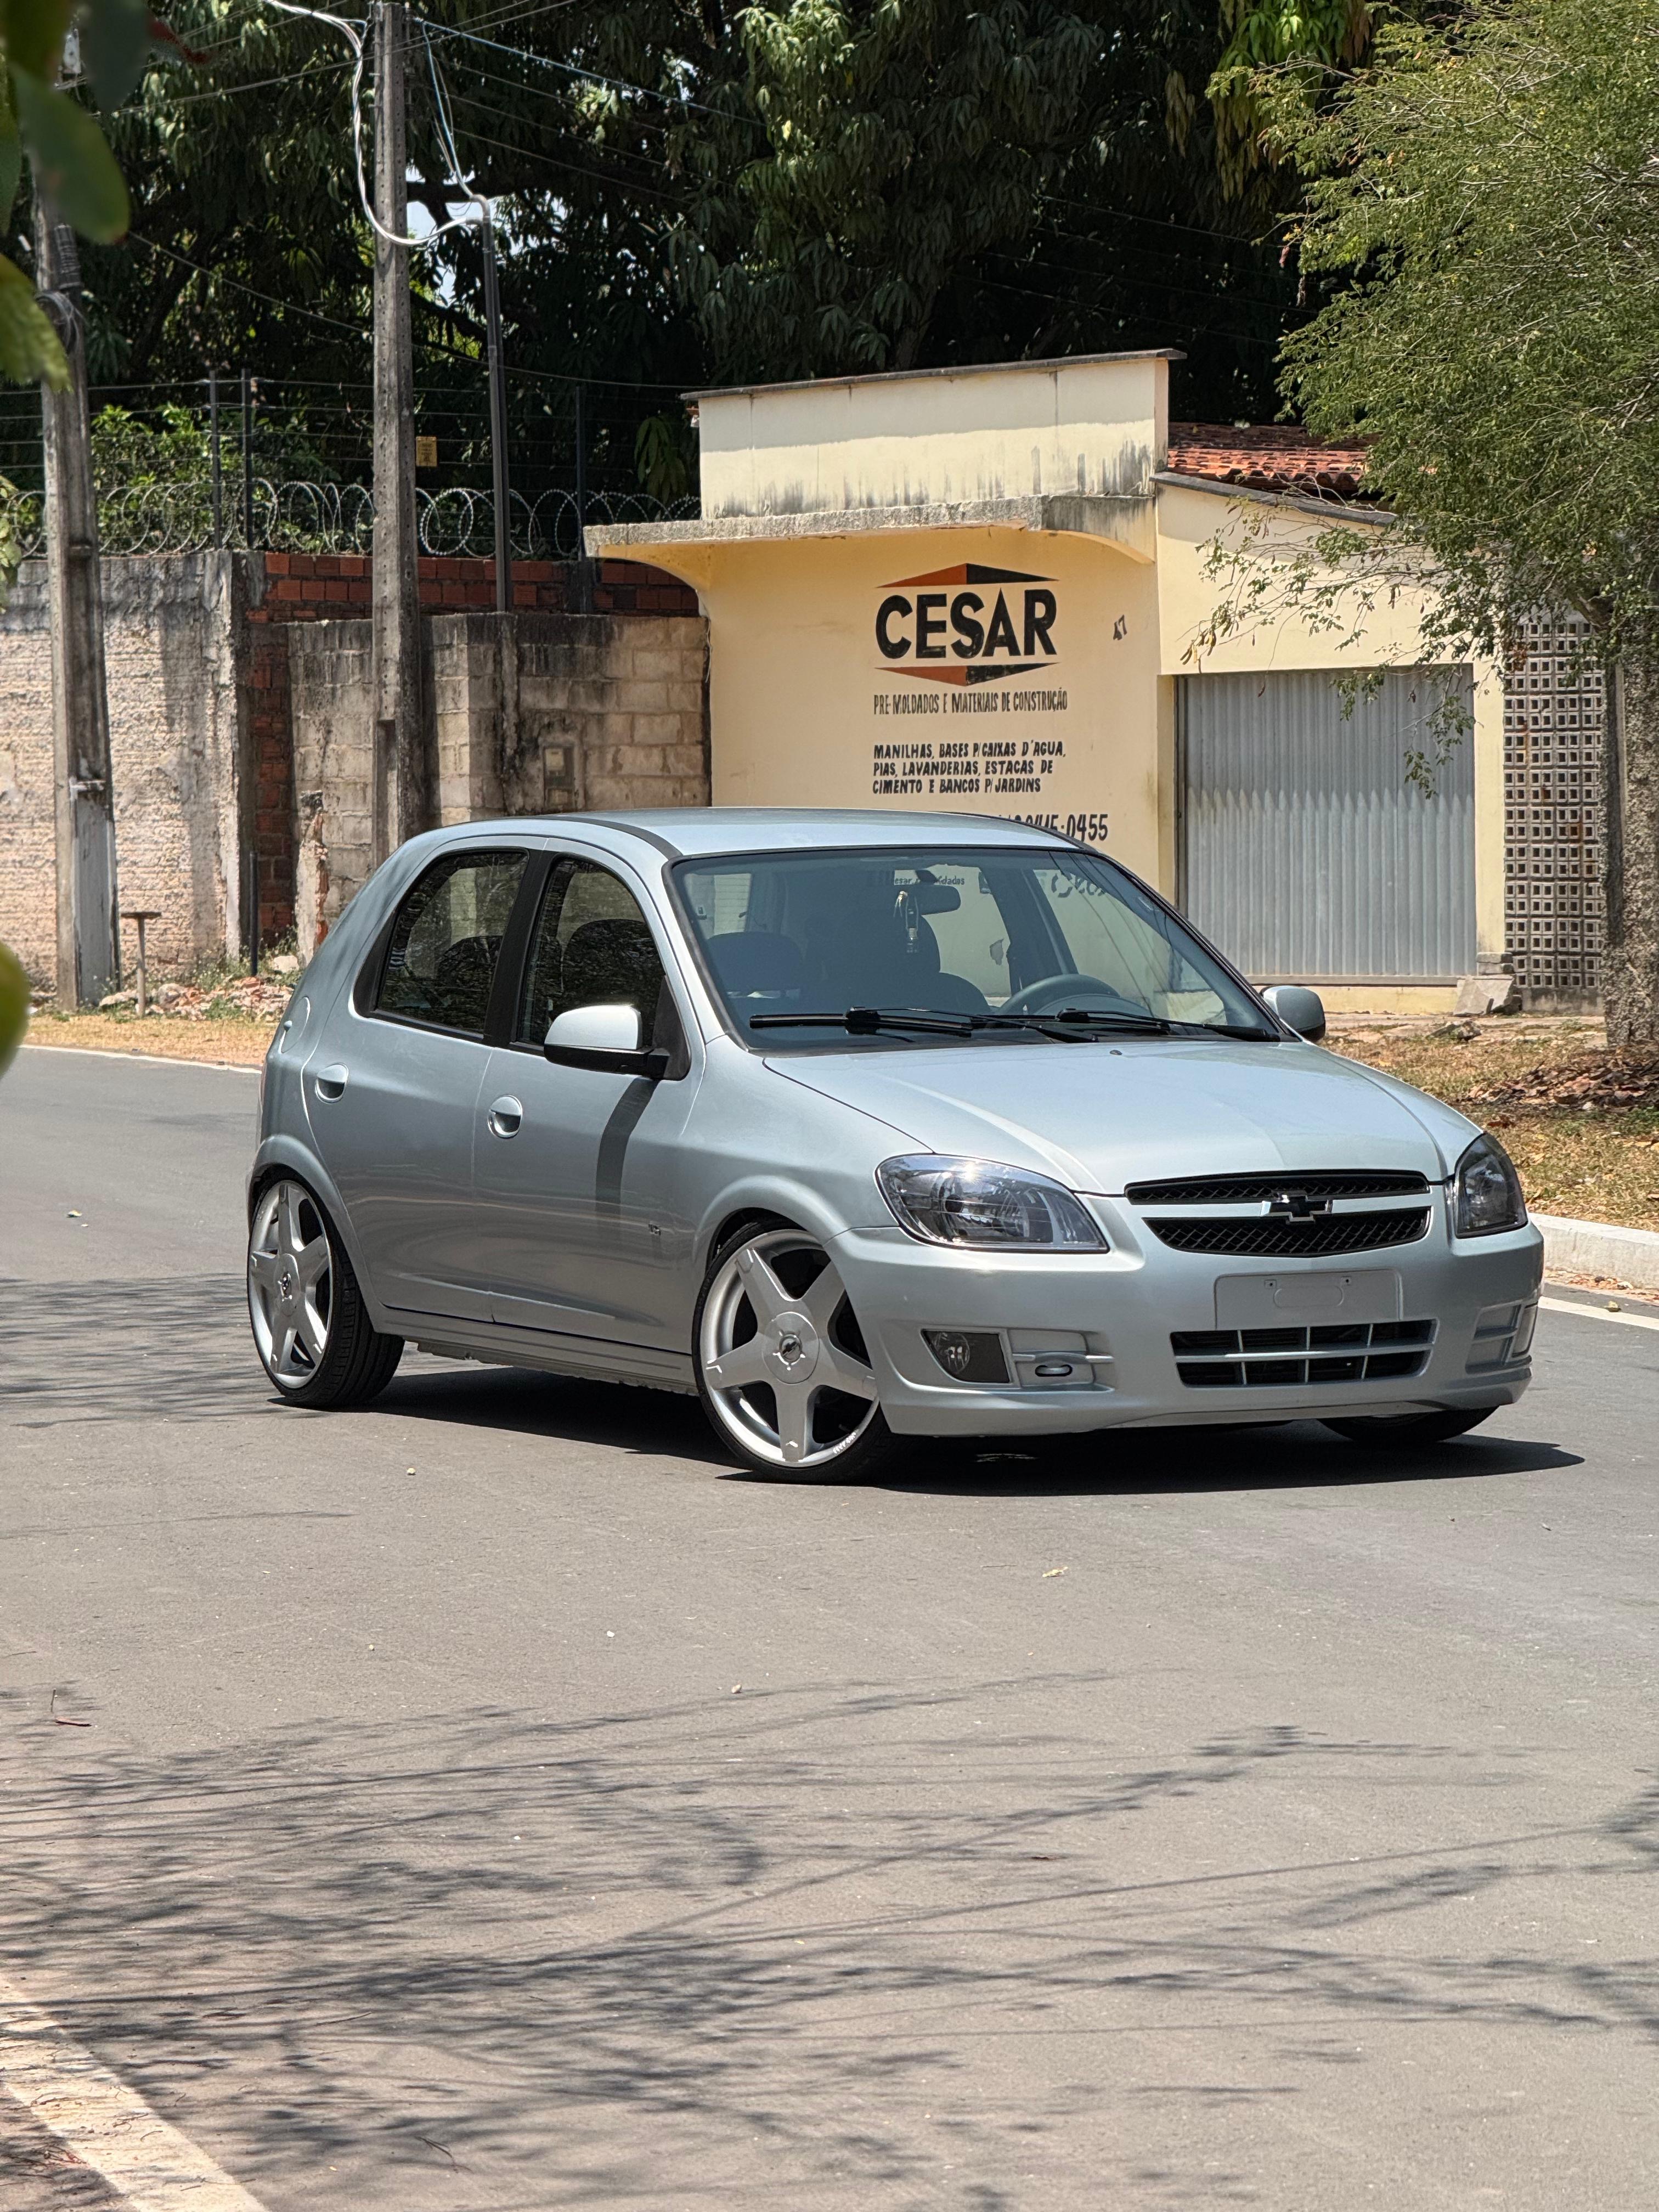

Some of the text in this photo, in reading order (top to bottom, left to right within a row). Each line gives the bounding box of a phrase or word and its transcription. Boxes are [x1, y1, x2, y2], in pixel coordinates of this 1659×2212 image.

[876, 588, 1057, 659] CESAR
[943, 693, 948, 714] E
[952, 692, 998, 713] MATERIAIS
[1002, 691, 1011, 712] DE
[874, 744, 934, 759] MANILHAS,
[939, 743, 968, 758] BASES
[873, 759, 1053, 778] PIAS, LAVANDERIAS, ESTACAS DE
[873, 779, 923, 794] CIMENTO
[929, 778, 935, 793] E
[939, 778, 980, 794] BANCOS
